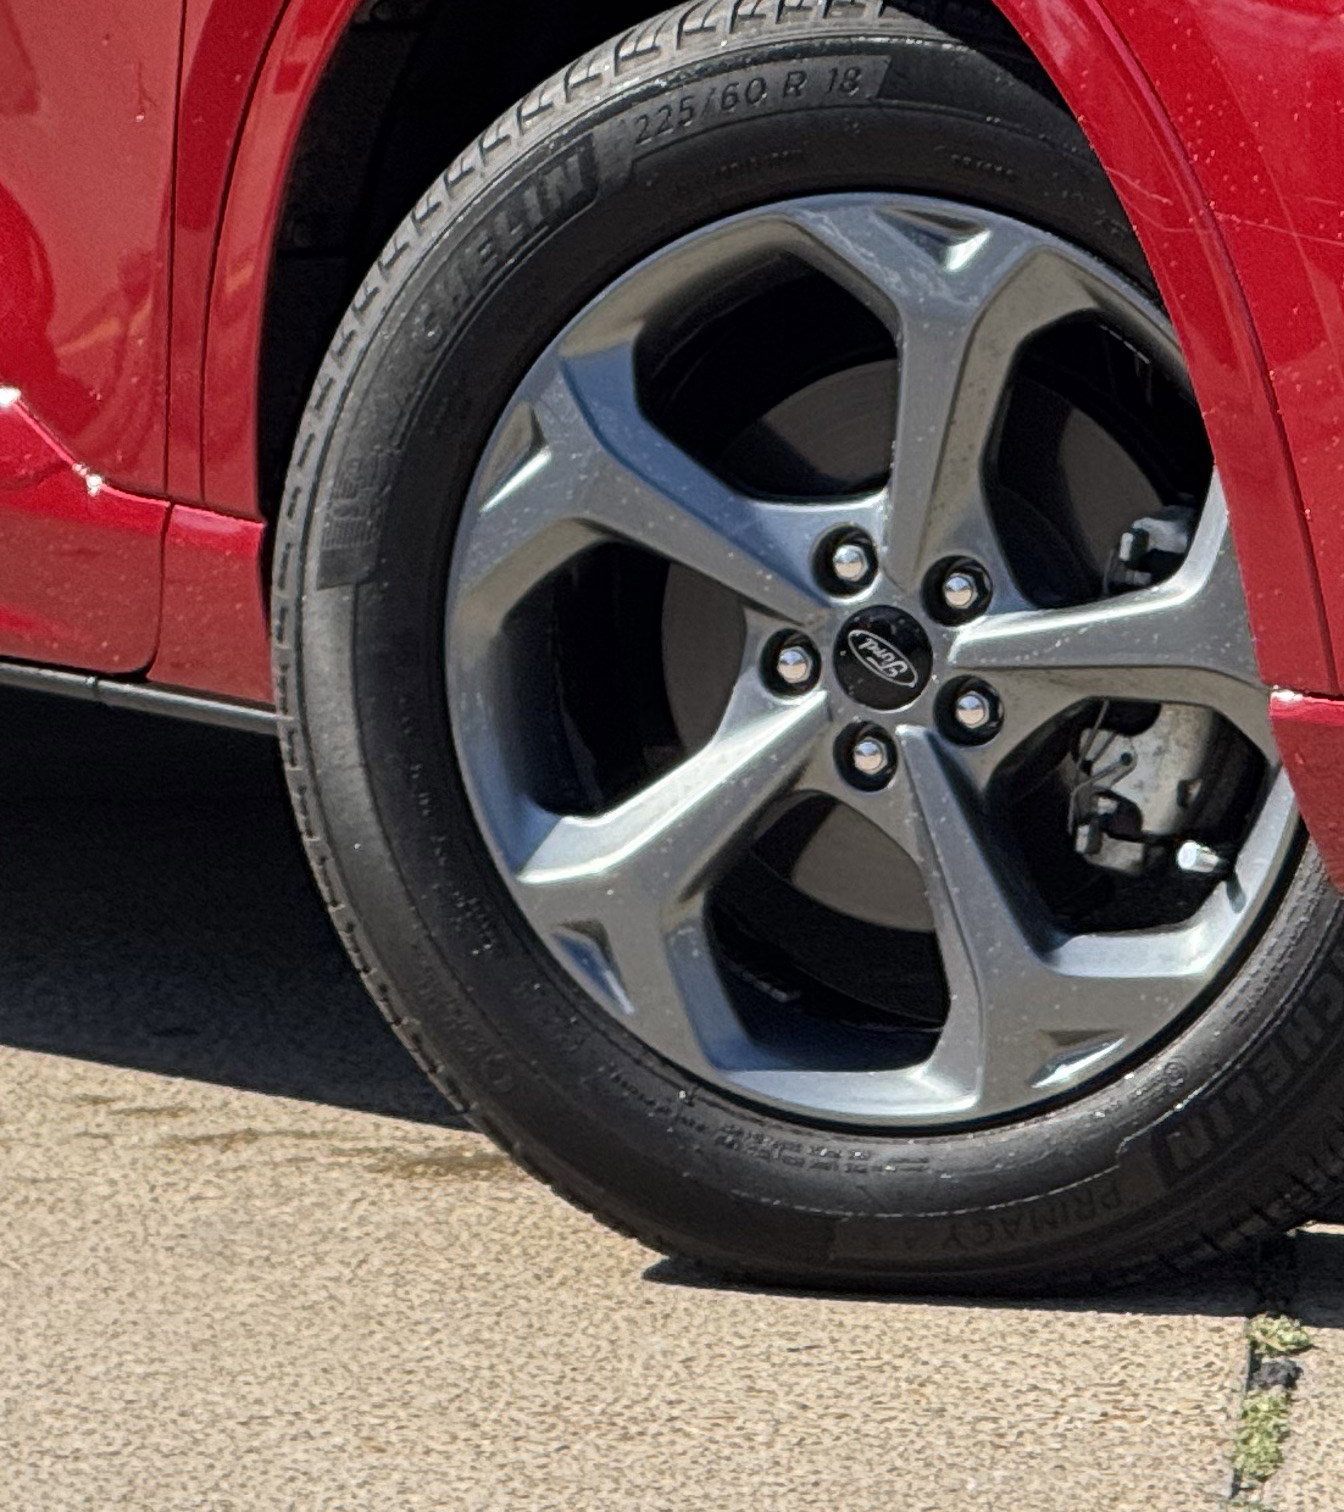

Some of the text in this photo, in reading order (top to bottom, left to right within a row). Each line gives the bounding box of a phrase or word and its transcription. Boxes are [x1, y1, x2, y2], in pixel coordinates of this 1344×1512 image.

[634, 65, 863, 145] 225/60 R 18
[940, 1186, 1122, 1251] PRIMACY
